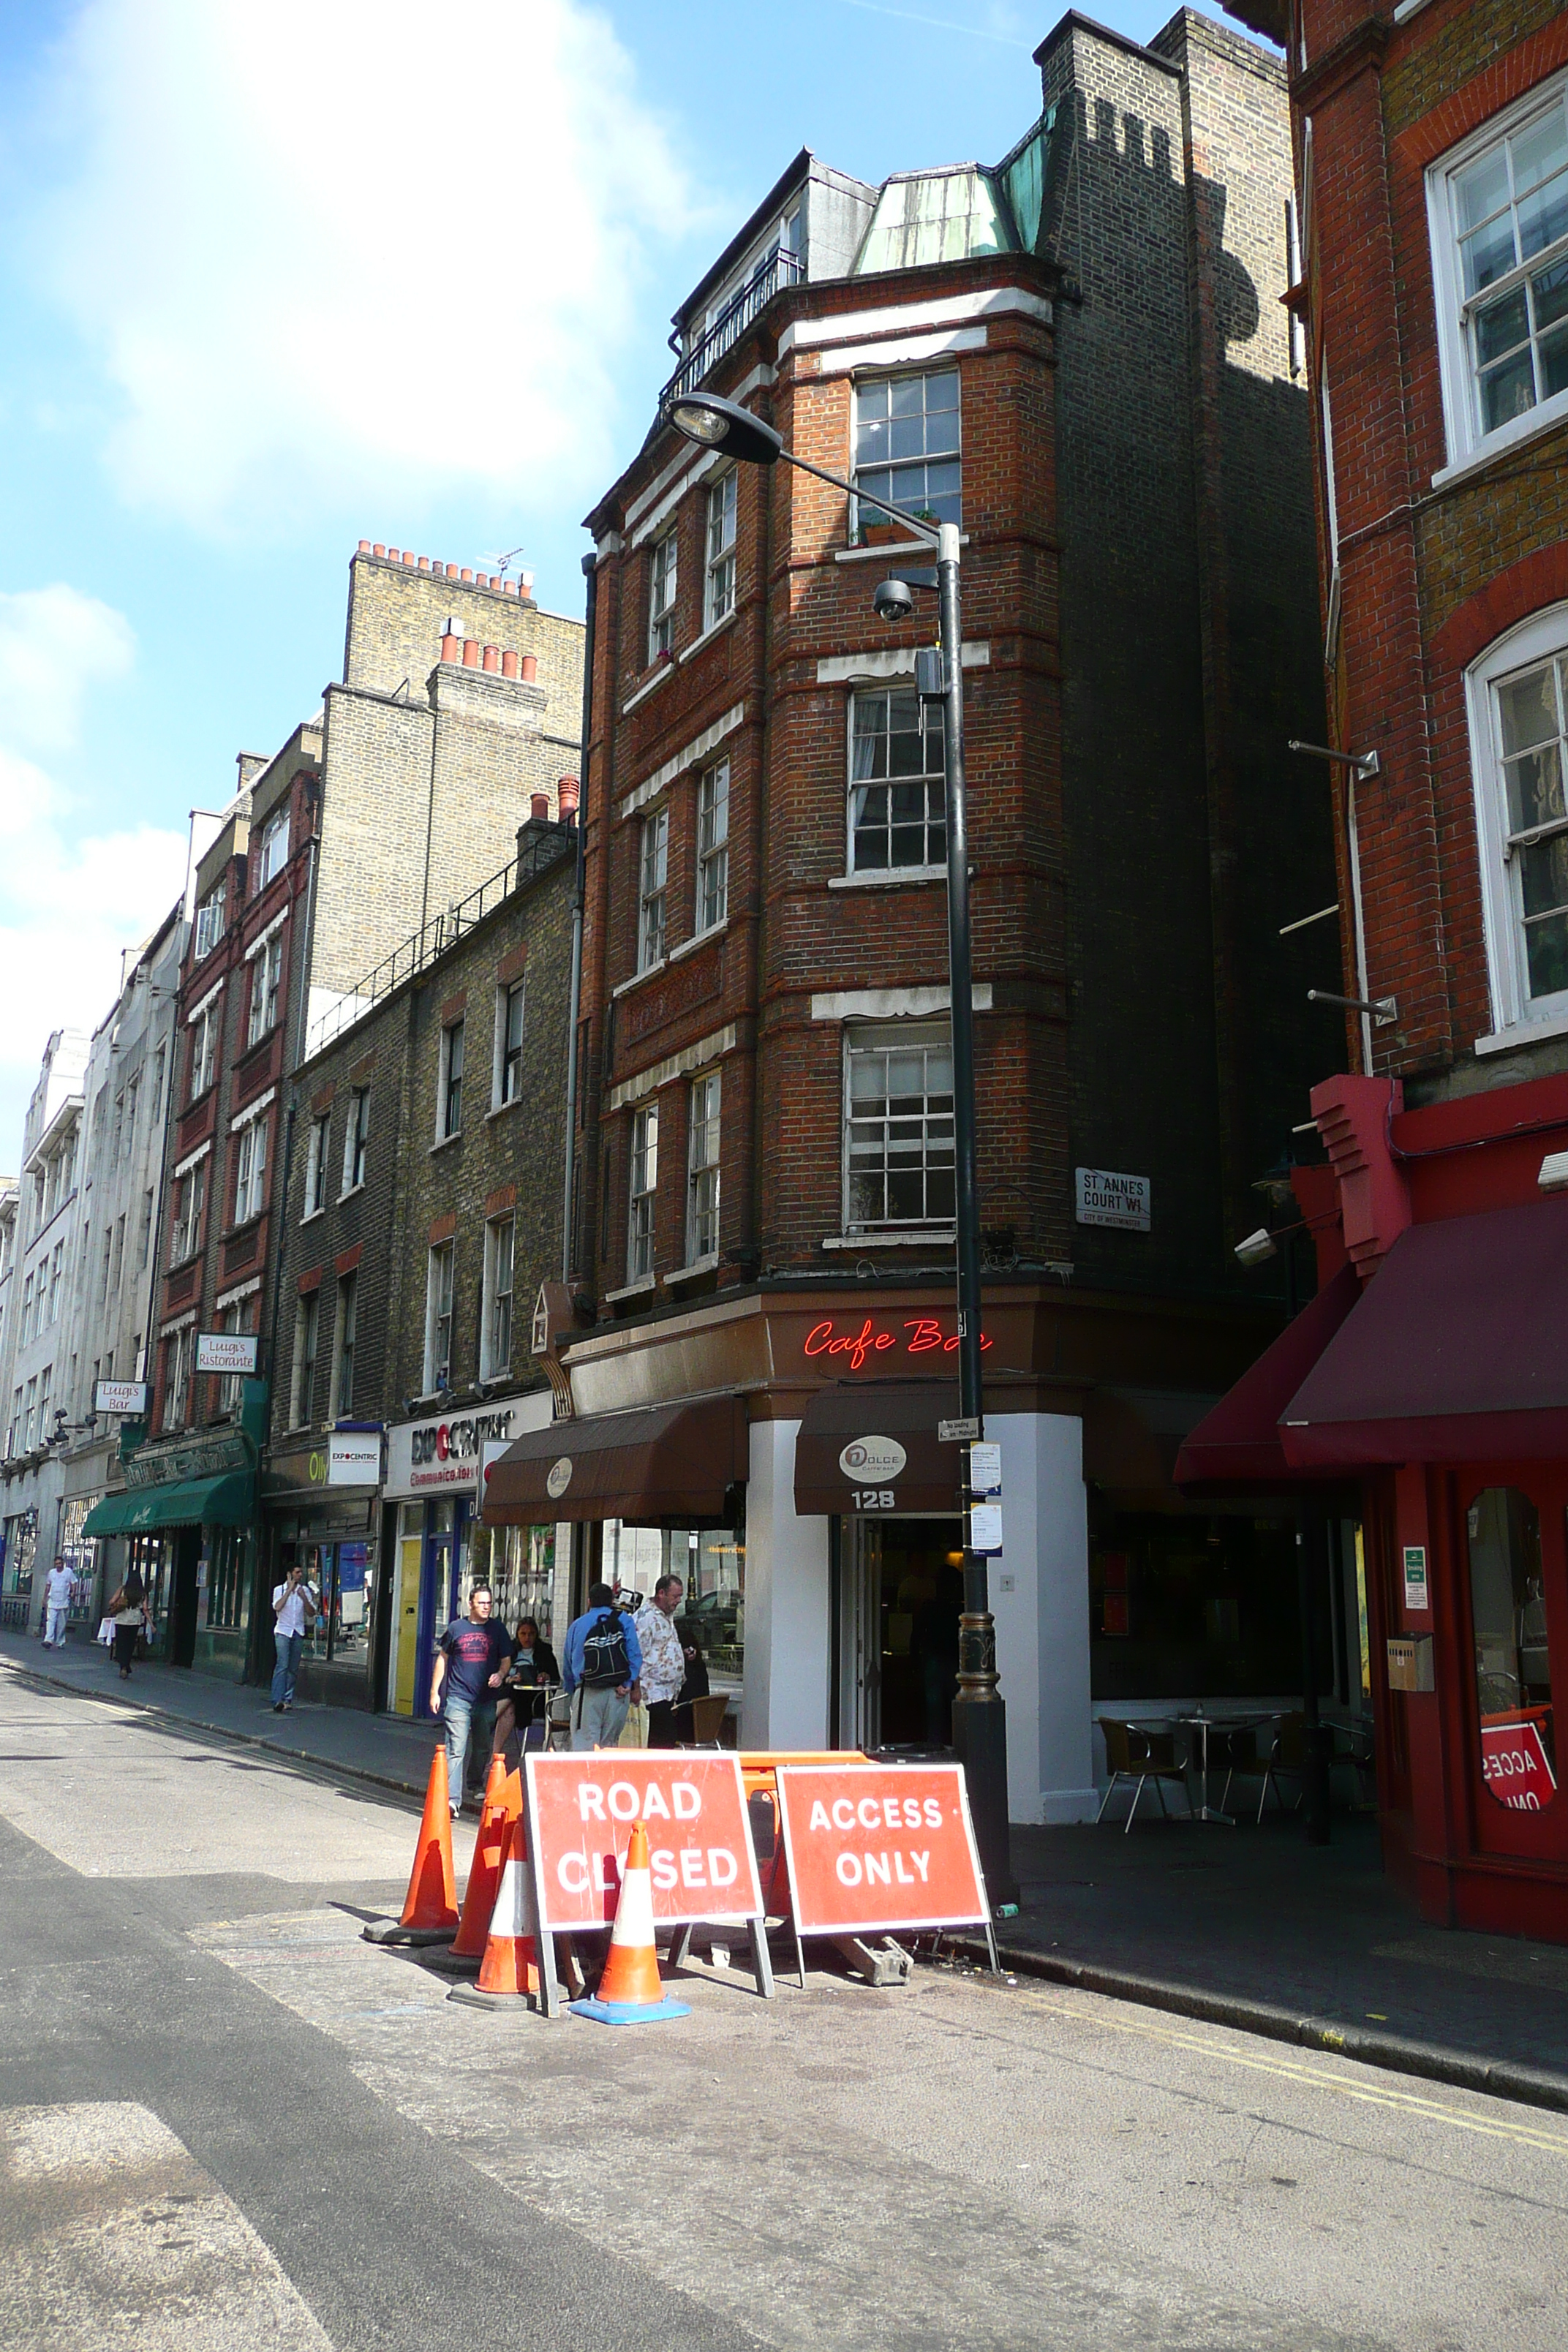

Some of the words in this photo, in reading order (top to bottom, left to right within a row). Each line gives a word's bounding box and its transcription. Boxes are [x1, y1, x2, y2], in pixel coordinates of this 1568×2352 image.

[1104, 1177, 1144, 1196] ANNE'S
[1085, 1191, 1122, 1209] COURT
[1126, 1197, 1140, 1213] W1
[1084, 1213, 1096, 1221] CITY
[1105, 1215, 1140, 1227] WESTMINSTER
[209, 1341, 246, 1355] Luigi's
[804, 1319, 896, 1369] Cafe
[200, 1353, 253, 1368] Ristorante
[102, 1382, 139, 1399] Luigi's
[109, 1398, 130, 1410] Bar
[846, 1445, 900, 1467] DOLCE
[851, 1490, 895, 1509] 128
[577, 1781, 703, 1821] ROAD
[809, 1797, 943, 1831] ACCESS
[557, 1847, 739, 1893] CLSED
[835, 1850, 932, 1888] ONLY
